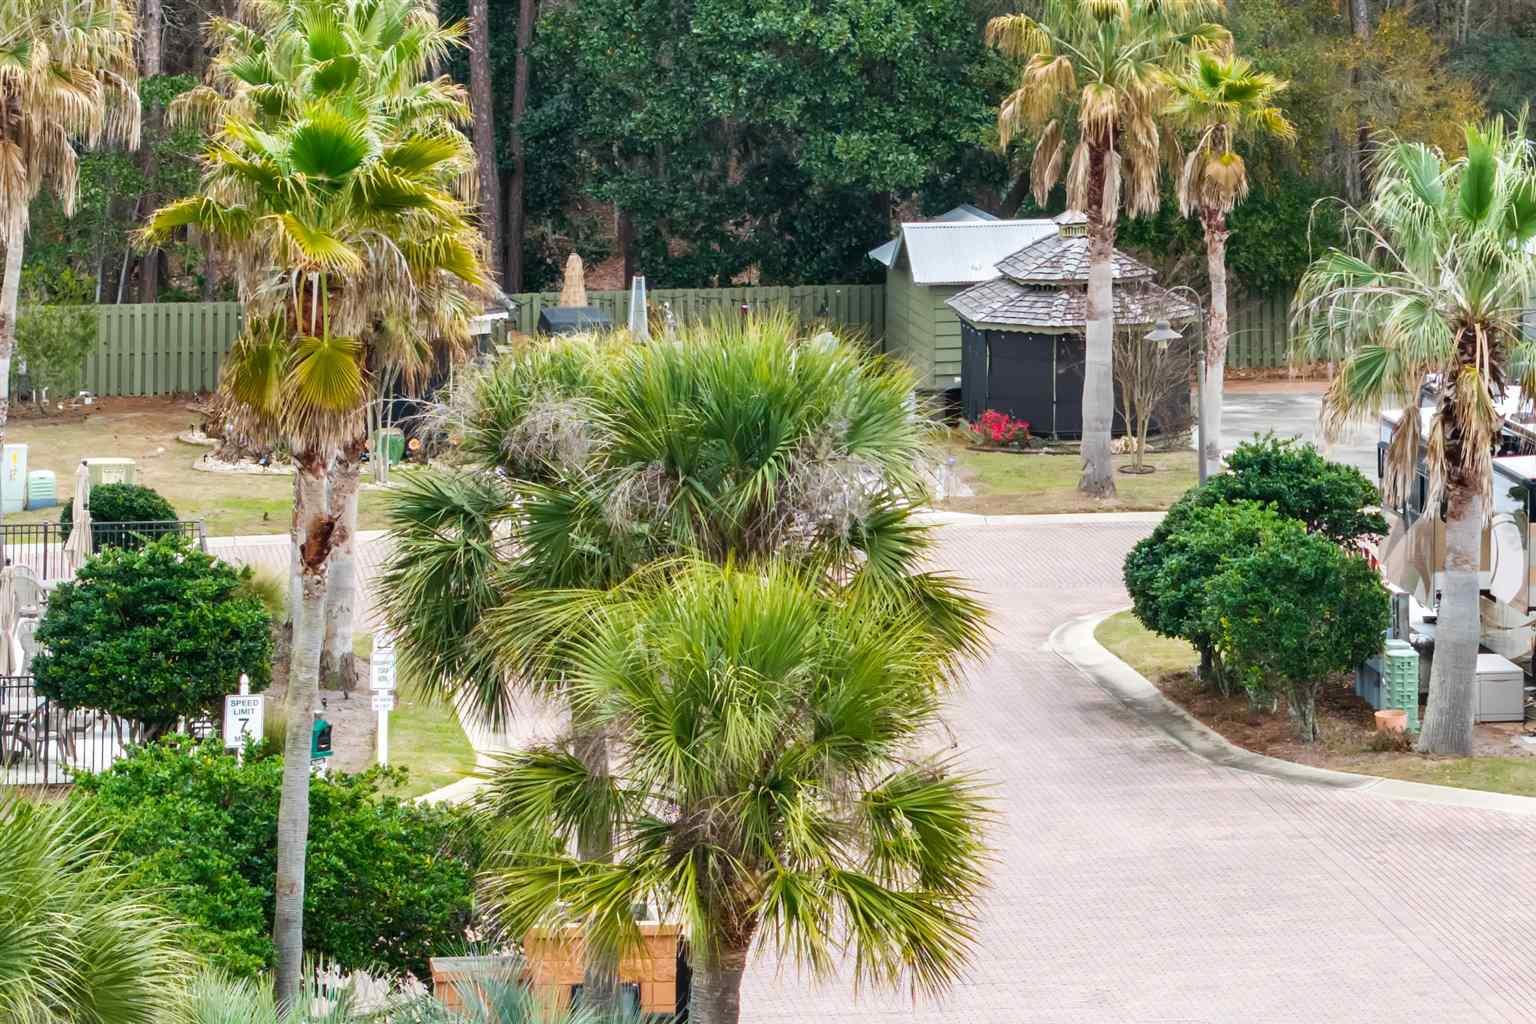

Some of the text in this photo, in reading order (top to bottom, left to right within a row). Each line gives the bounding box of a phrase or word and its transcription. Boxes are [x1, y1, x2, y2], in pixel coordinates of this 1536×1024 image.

[230, 699, 259, 707] SPEED
[233, 708, 255, 716] LIMIT
[238, 717, 250, 734] 7
